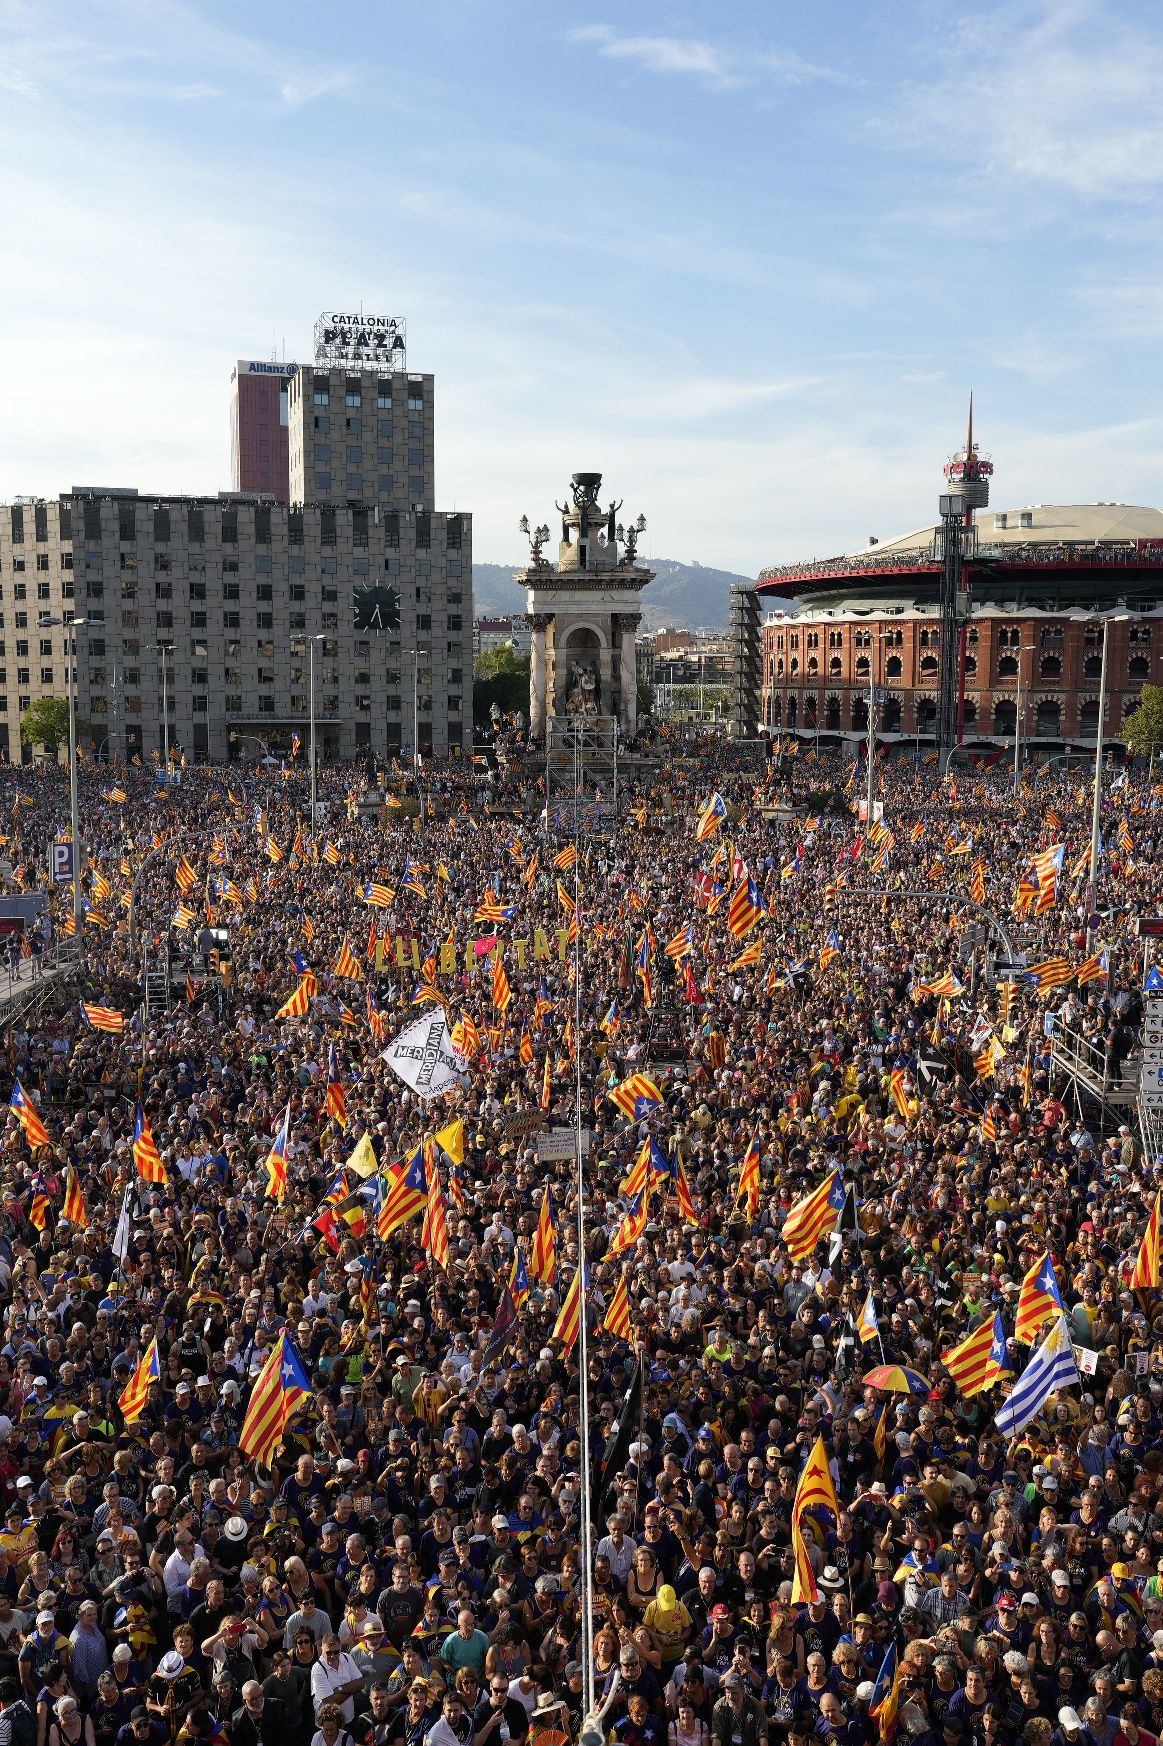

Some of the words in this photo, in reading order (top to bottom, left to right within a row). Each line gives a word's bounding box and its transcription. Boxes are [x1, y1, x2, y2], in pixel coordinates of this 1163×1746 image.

[332, 314, 397, 328] CATALONIA
[333, 326, 396, 335] BARCELONA
[324, 329, 405, 350] PLAZA
[340, 352, 391, 363] HOTEL
[249, 362, 285, 374] Allianz
[54, 845, 69, 873] P
[416, 1021, 446, 1086] MERIDIANA
